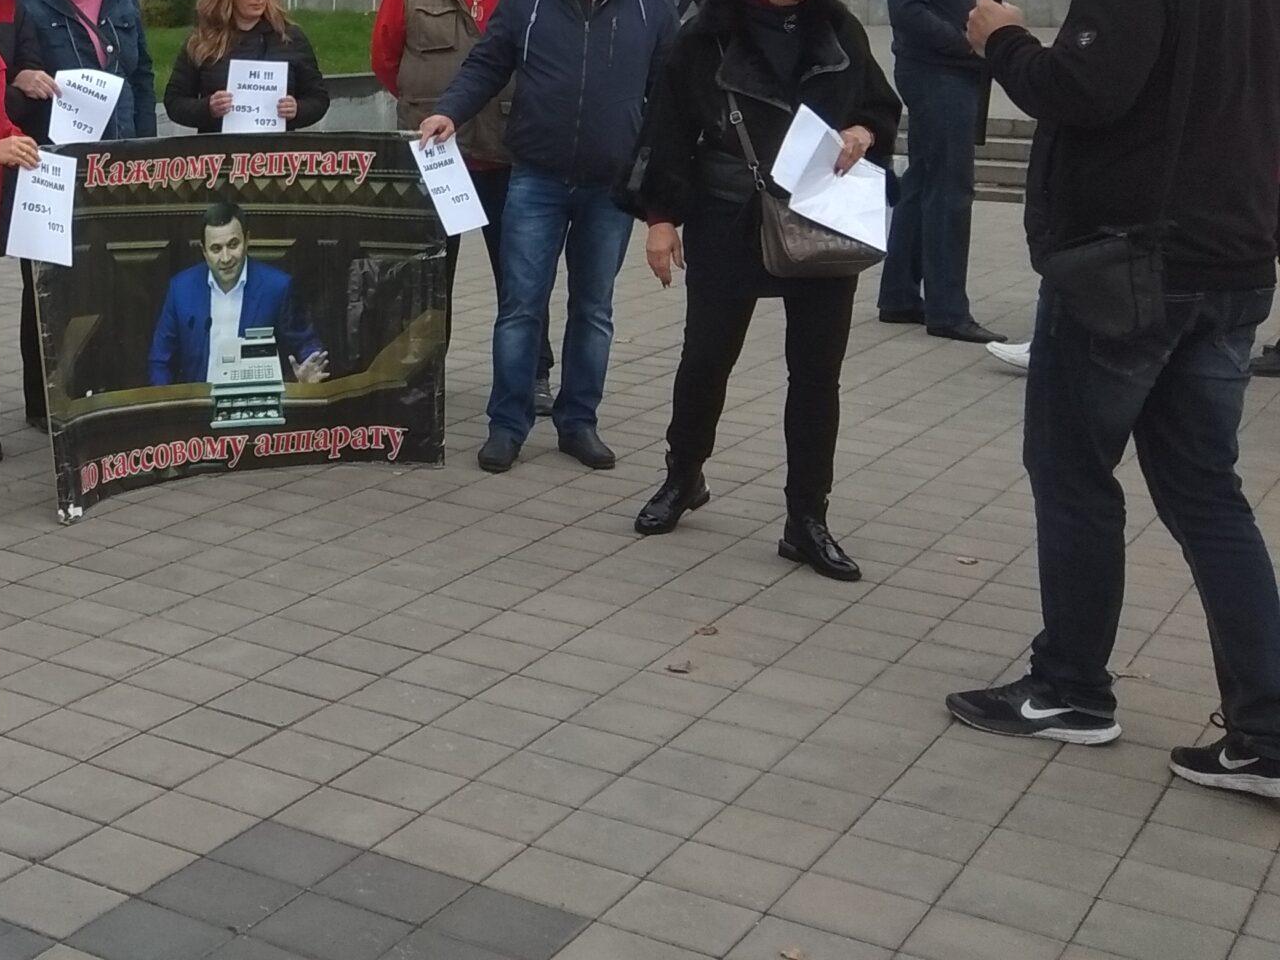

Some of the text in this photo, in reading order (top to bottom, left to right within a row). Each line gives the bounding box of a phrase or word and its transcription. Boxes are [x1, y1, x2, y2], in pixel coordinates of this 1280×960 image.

[65, 79, 108, 102] ЗАКОНАМ
[236, 82, 278, 92] ЗАКОНАМ
[56, 98, 80, 115] 053-1
[72, 120, 94, 135] 1073
[254, 118, 277, 127] 1073
[85, 150, 376, 188] Каждому депутату
[32, 175, 65, 191] ЗАКОНАМ
[451, 193, 470, 205] 1073
[22, 201, 51, 215] 1053-1
[48, 221, 64, 234] 1073
[101, 434, 249, 484] кассовому
[254, 424, 409, 461] аппарату
